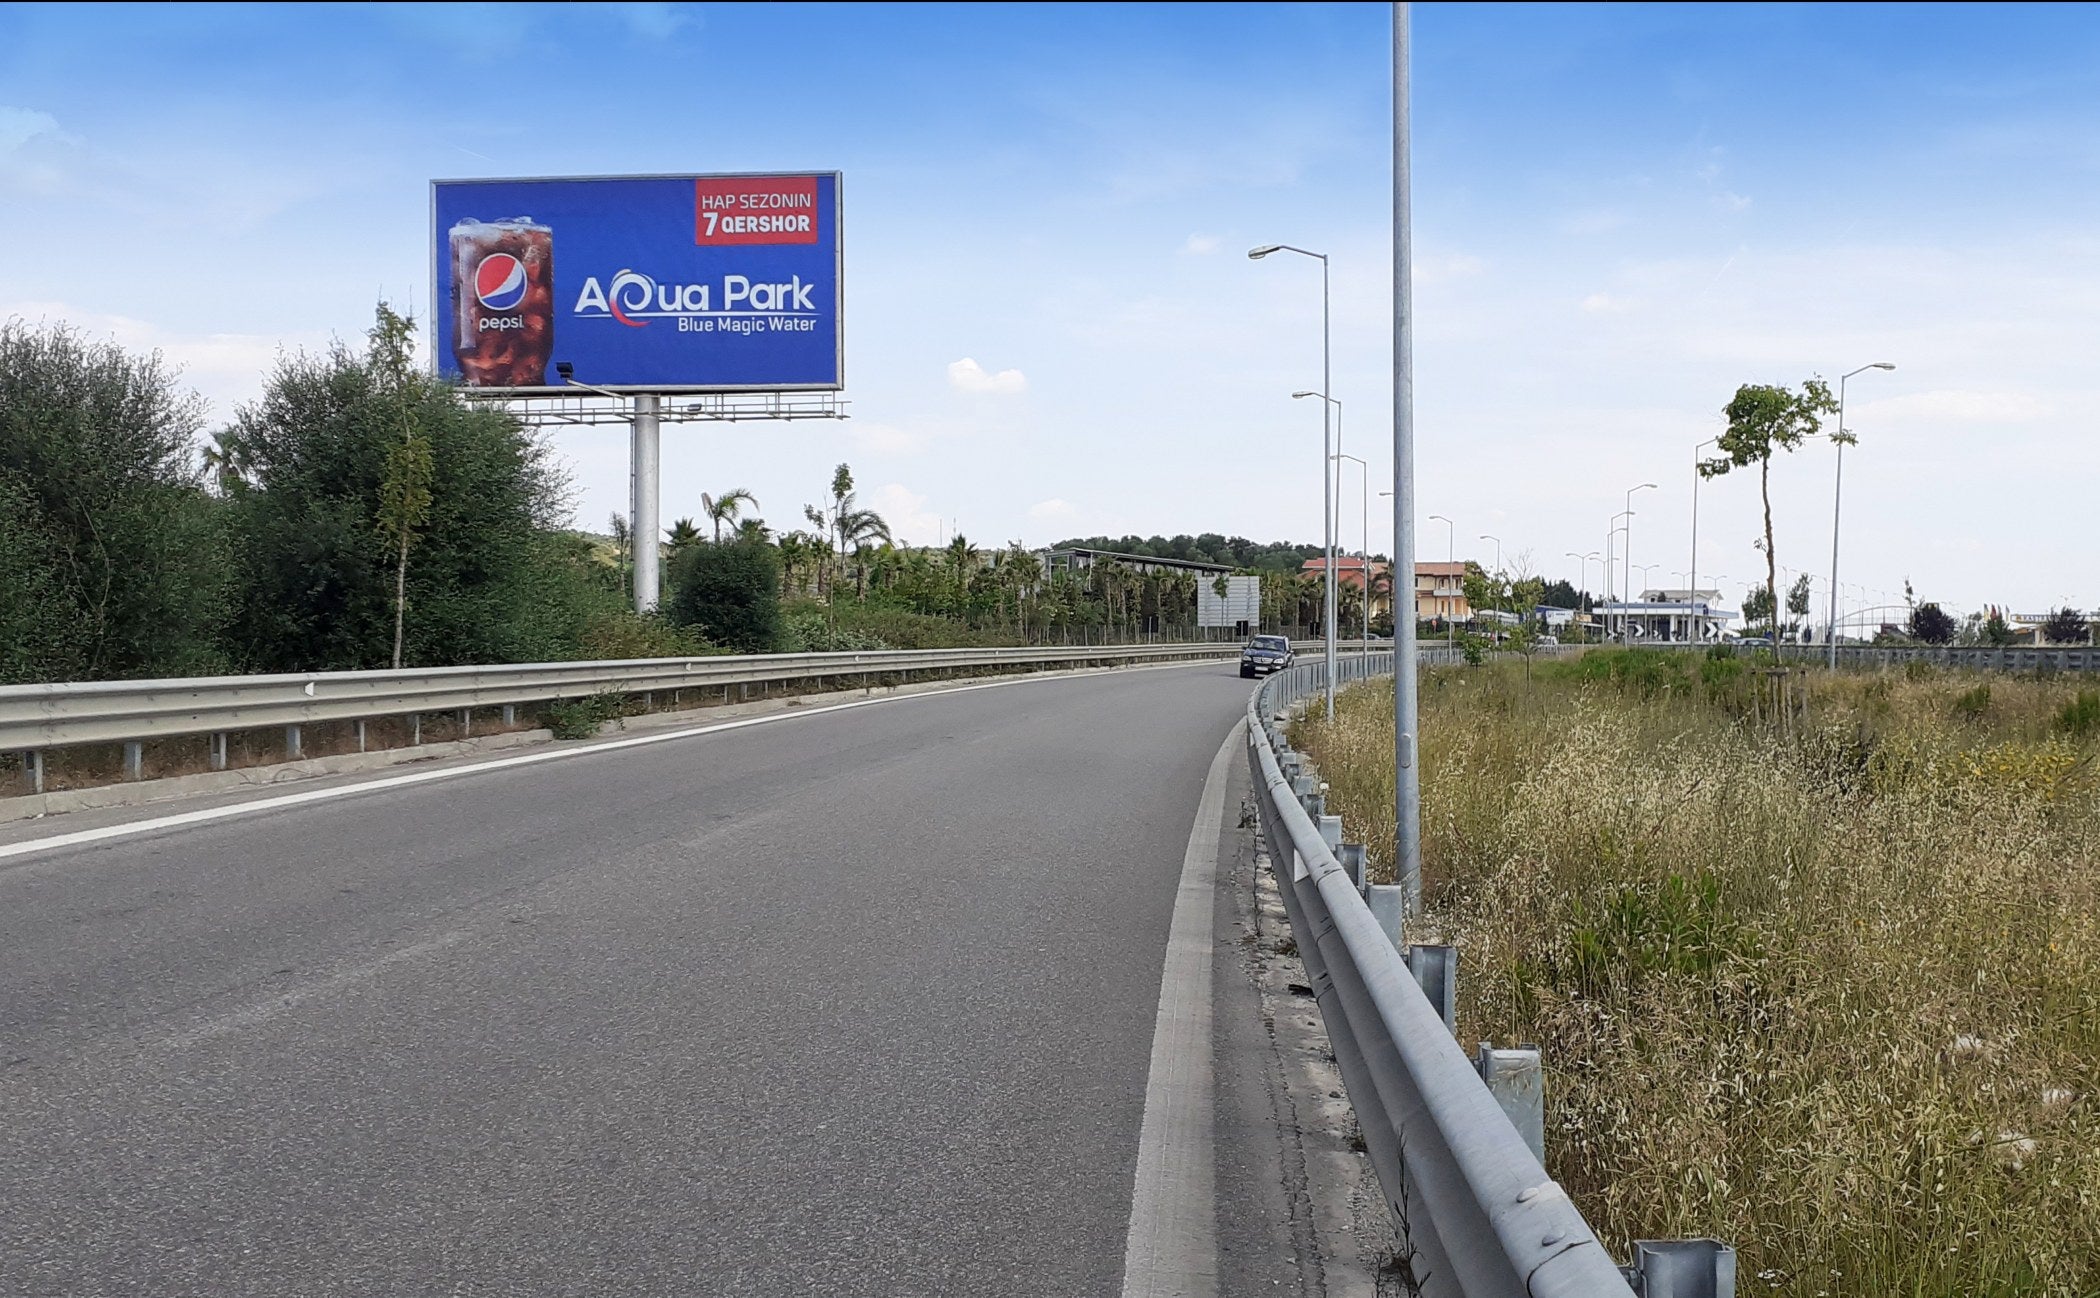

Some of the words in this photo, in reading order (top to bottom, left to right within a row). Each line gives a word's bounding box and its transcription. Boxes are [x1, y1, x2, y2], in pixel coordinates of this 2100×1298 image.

[702, 195, 735, 209] HAP
[740, 194, 811, 209] SEZONIN
[703, 212, 718, 236] 7
[722, 215, 810, 233] QERSHOR
[574, 269, 709, 327] AQua
[724, 275, 816, 310] Park
[479, 315, 523, 332] pepsi
[678, 317, 714, 332] Blue
[718, 317, 765, 336] Magic
[768, 317, 817, 331] Water
